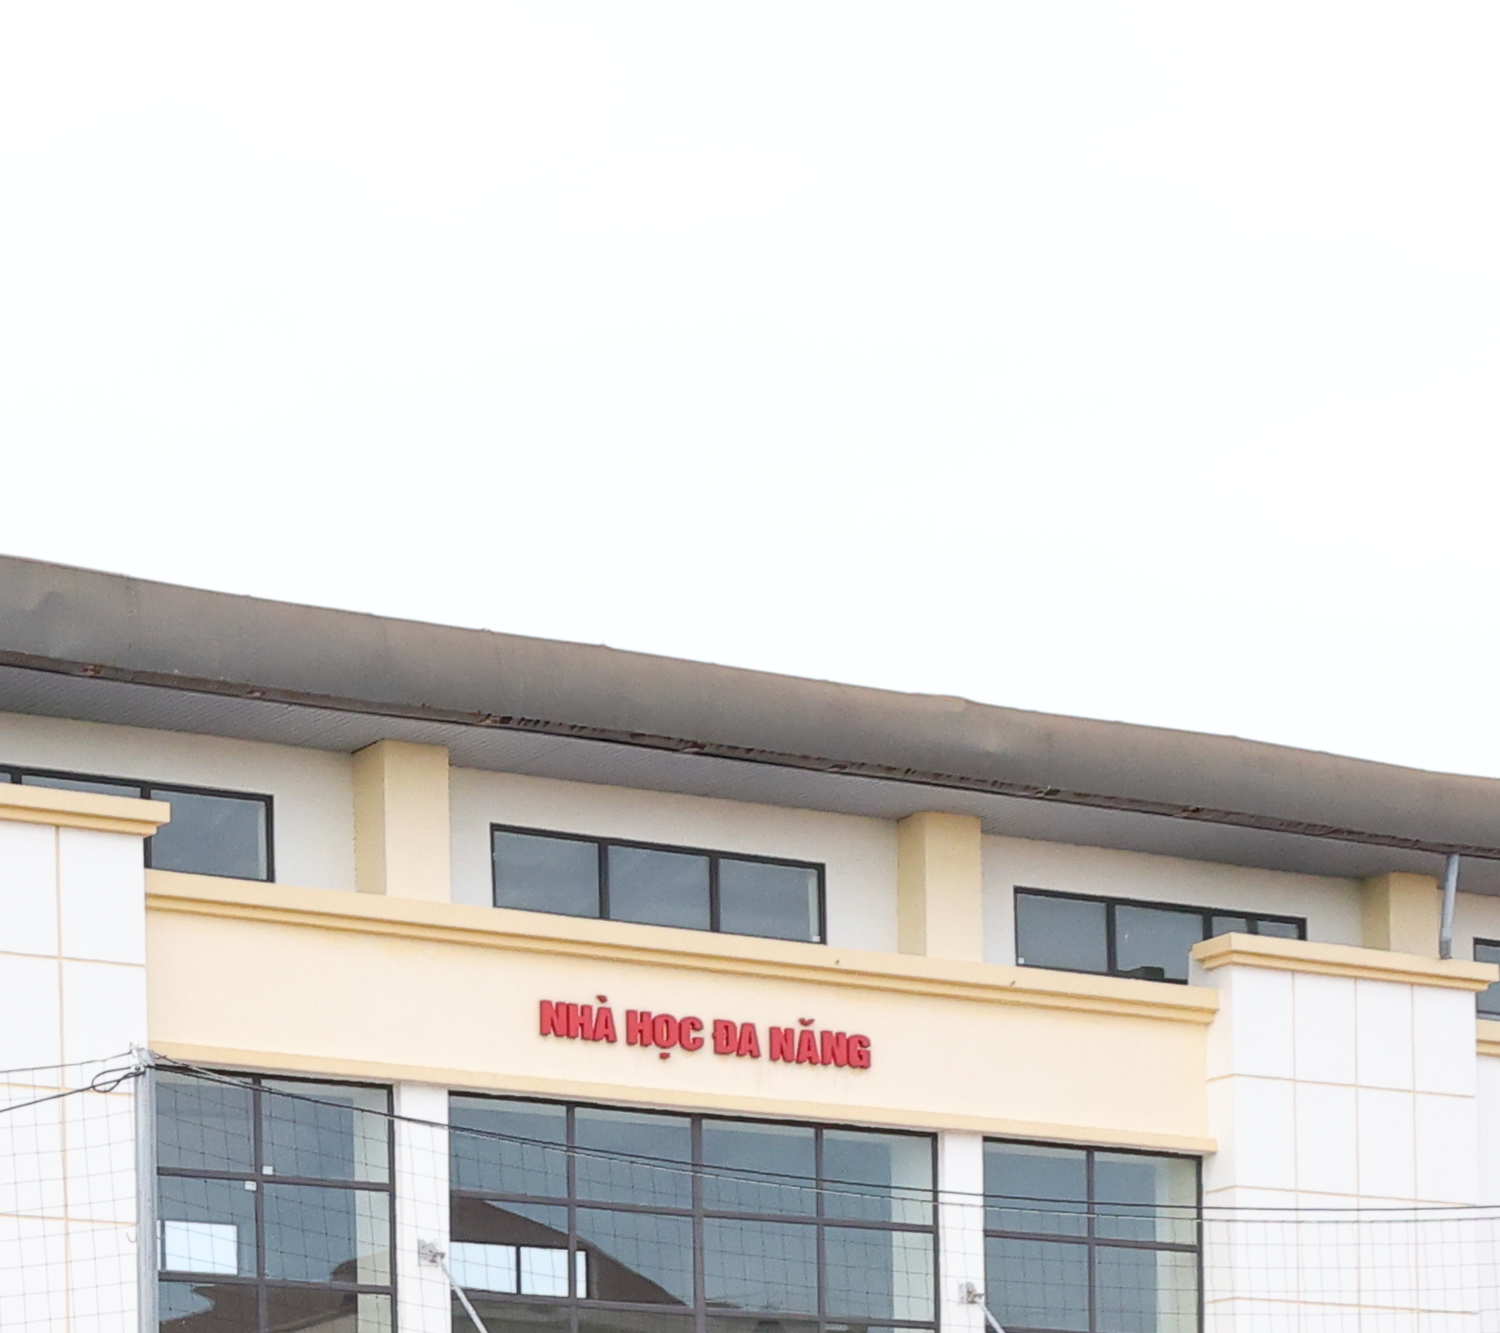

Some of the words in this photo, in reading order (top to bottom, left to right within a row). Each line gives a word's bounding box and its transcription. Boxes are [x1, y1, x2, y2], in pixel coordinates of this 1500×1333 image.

[539, 994, 617, 1043] NHÀ
[626, 1010, 704, 1060] HỌC
[713, 1019, 761, 1058] ĐA
[769, 1018, 872, 1069] NĂNG
